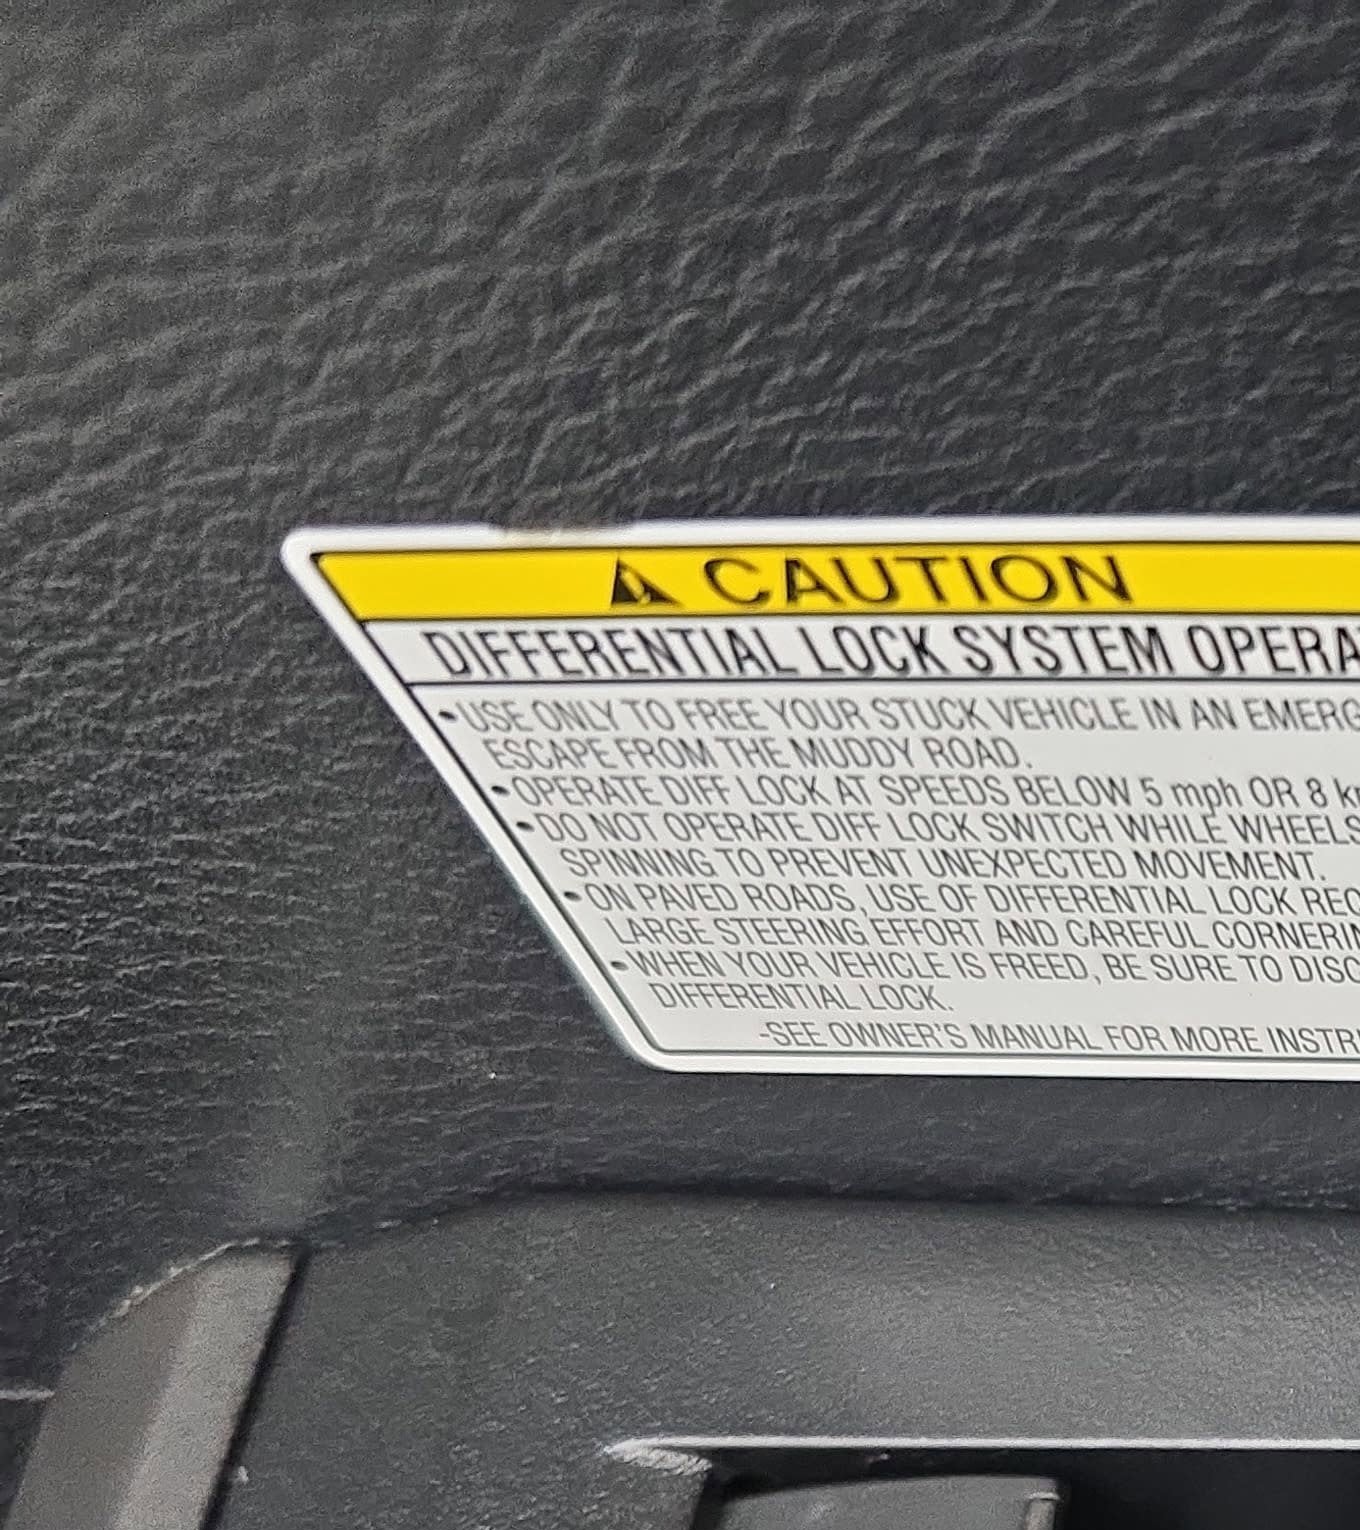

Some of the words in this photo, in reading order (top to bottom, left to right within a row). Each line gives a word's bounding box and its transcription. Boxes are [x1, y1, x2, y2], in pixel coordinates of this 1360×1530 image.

[702, 554, 1135, 608] CAUTION
[418, 627, 800, 678] DIFFERENTIAL
[794, 626, 951, 676] LOCK
[951, 625, 1176, 676] SYSTEM
[454, 699, 535, 733] USE
[530, 698, 621, 732] ONLY
[619, 698, 677, 732] TO
[673, 698, 770, 732] FREE
[762, 697, 871, 732] YOUR
[869, 696, 992, 731] STUCK
[985, 696, 1139, 731] VEHICLE
[1138, 697, 1183, 732] IN
[1189, 697, 1239, 732] AN
[481, 737, 619, 769] ESCAPE
[612, 737, 720, 769] FROM
[713, 737, 792, 769] THE
[786, 737, 916, 769] MUDDY
[919, 736, 1033, 769] ROAD.
[510, 775, 664, 807] OPERATE
[657, 775, 731, 806] DIFF
[734, 775, 833, 807] LOCK
[833, 774, 873, 807] AT
[877, 774, 1011, 807] SPEEDS
[1011, 774, 1133, 808] BELOW
[1137, 775, 1164, 808] 5
[1169, 775, 1244, 815] mph
[1247, 775, 1301, 809] OR
[1303, 776, 1329, 809] 8
[531, 811, 589, 842] DO
[585, 811, 659, 842] NOT
[661, 812, 814, 843] OPERATE
[809, 812, 882, 843] DIFF
[885, 812, 982, 843] LOCK
[979, 812, 1115, 844] SWITCH
[1112, 812, 1229, 845] WHILE
[558, 847, 720, 877] SPINNING
[712, 847, 766, 878] TO
[764, 848, 913, 878] PREVENT
[916, 848, 1128, 879] UNEXPECTED
[1130, 849, 1327, 881] MOVEMENT.
[583, 881, 638, 912] ON
[632, 882, 740, 912] PAVED
[738, 882, 869, 920] ROADS,
[864, 883, 938, 914] USE
[936, 883, 978, 914] OF
[982, 883, 1208, 916] DIFFERENTIAL
[1206, 885, 1299, 917] LOCK
[603, 916, 716, 946] LARGE
[711, 916, 871, 947] STEERING
[868, 917, 985, 948] EFFORT
[993, 917, 1060, 948] AND
[1064, 918, 1210, 950] CAREFUL
[623, 949, 727, 978] WHEN
[720, 950, 820, 979] YOUR
[814, 950, 952, 980] VEHICLE
[949, 951, 988, 980] IS
[987, 951, 1102, 988] FREED,
[1100, 952, 1149, 982] BE
[1148, 953, 1239, 983] SURE
[1235, 954, 1284, 984] TO
[646, 981, 863, 1011] DIFFERENTIAL
[857, 983, 955, 1012] LOCK.
[826, 1021, 969, 1049] OWNER'S
[968, 1022, 1104, 1051] MANUAL
[1101, 1024, 1169, 1051] FOR
[1168, 1025, 1264, 1053] MORE
